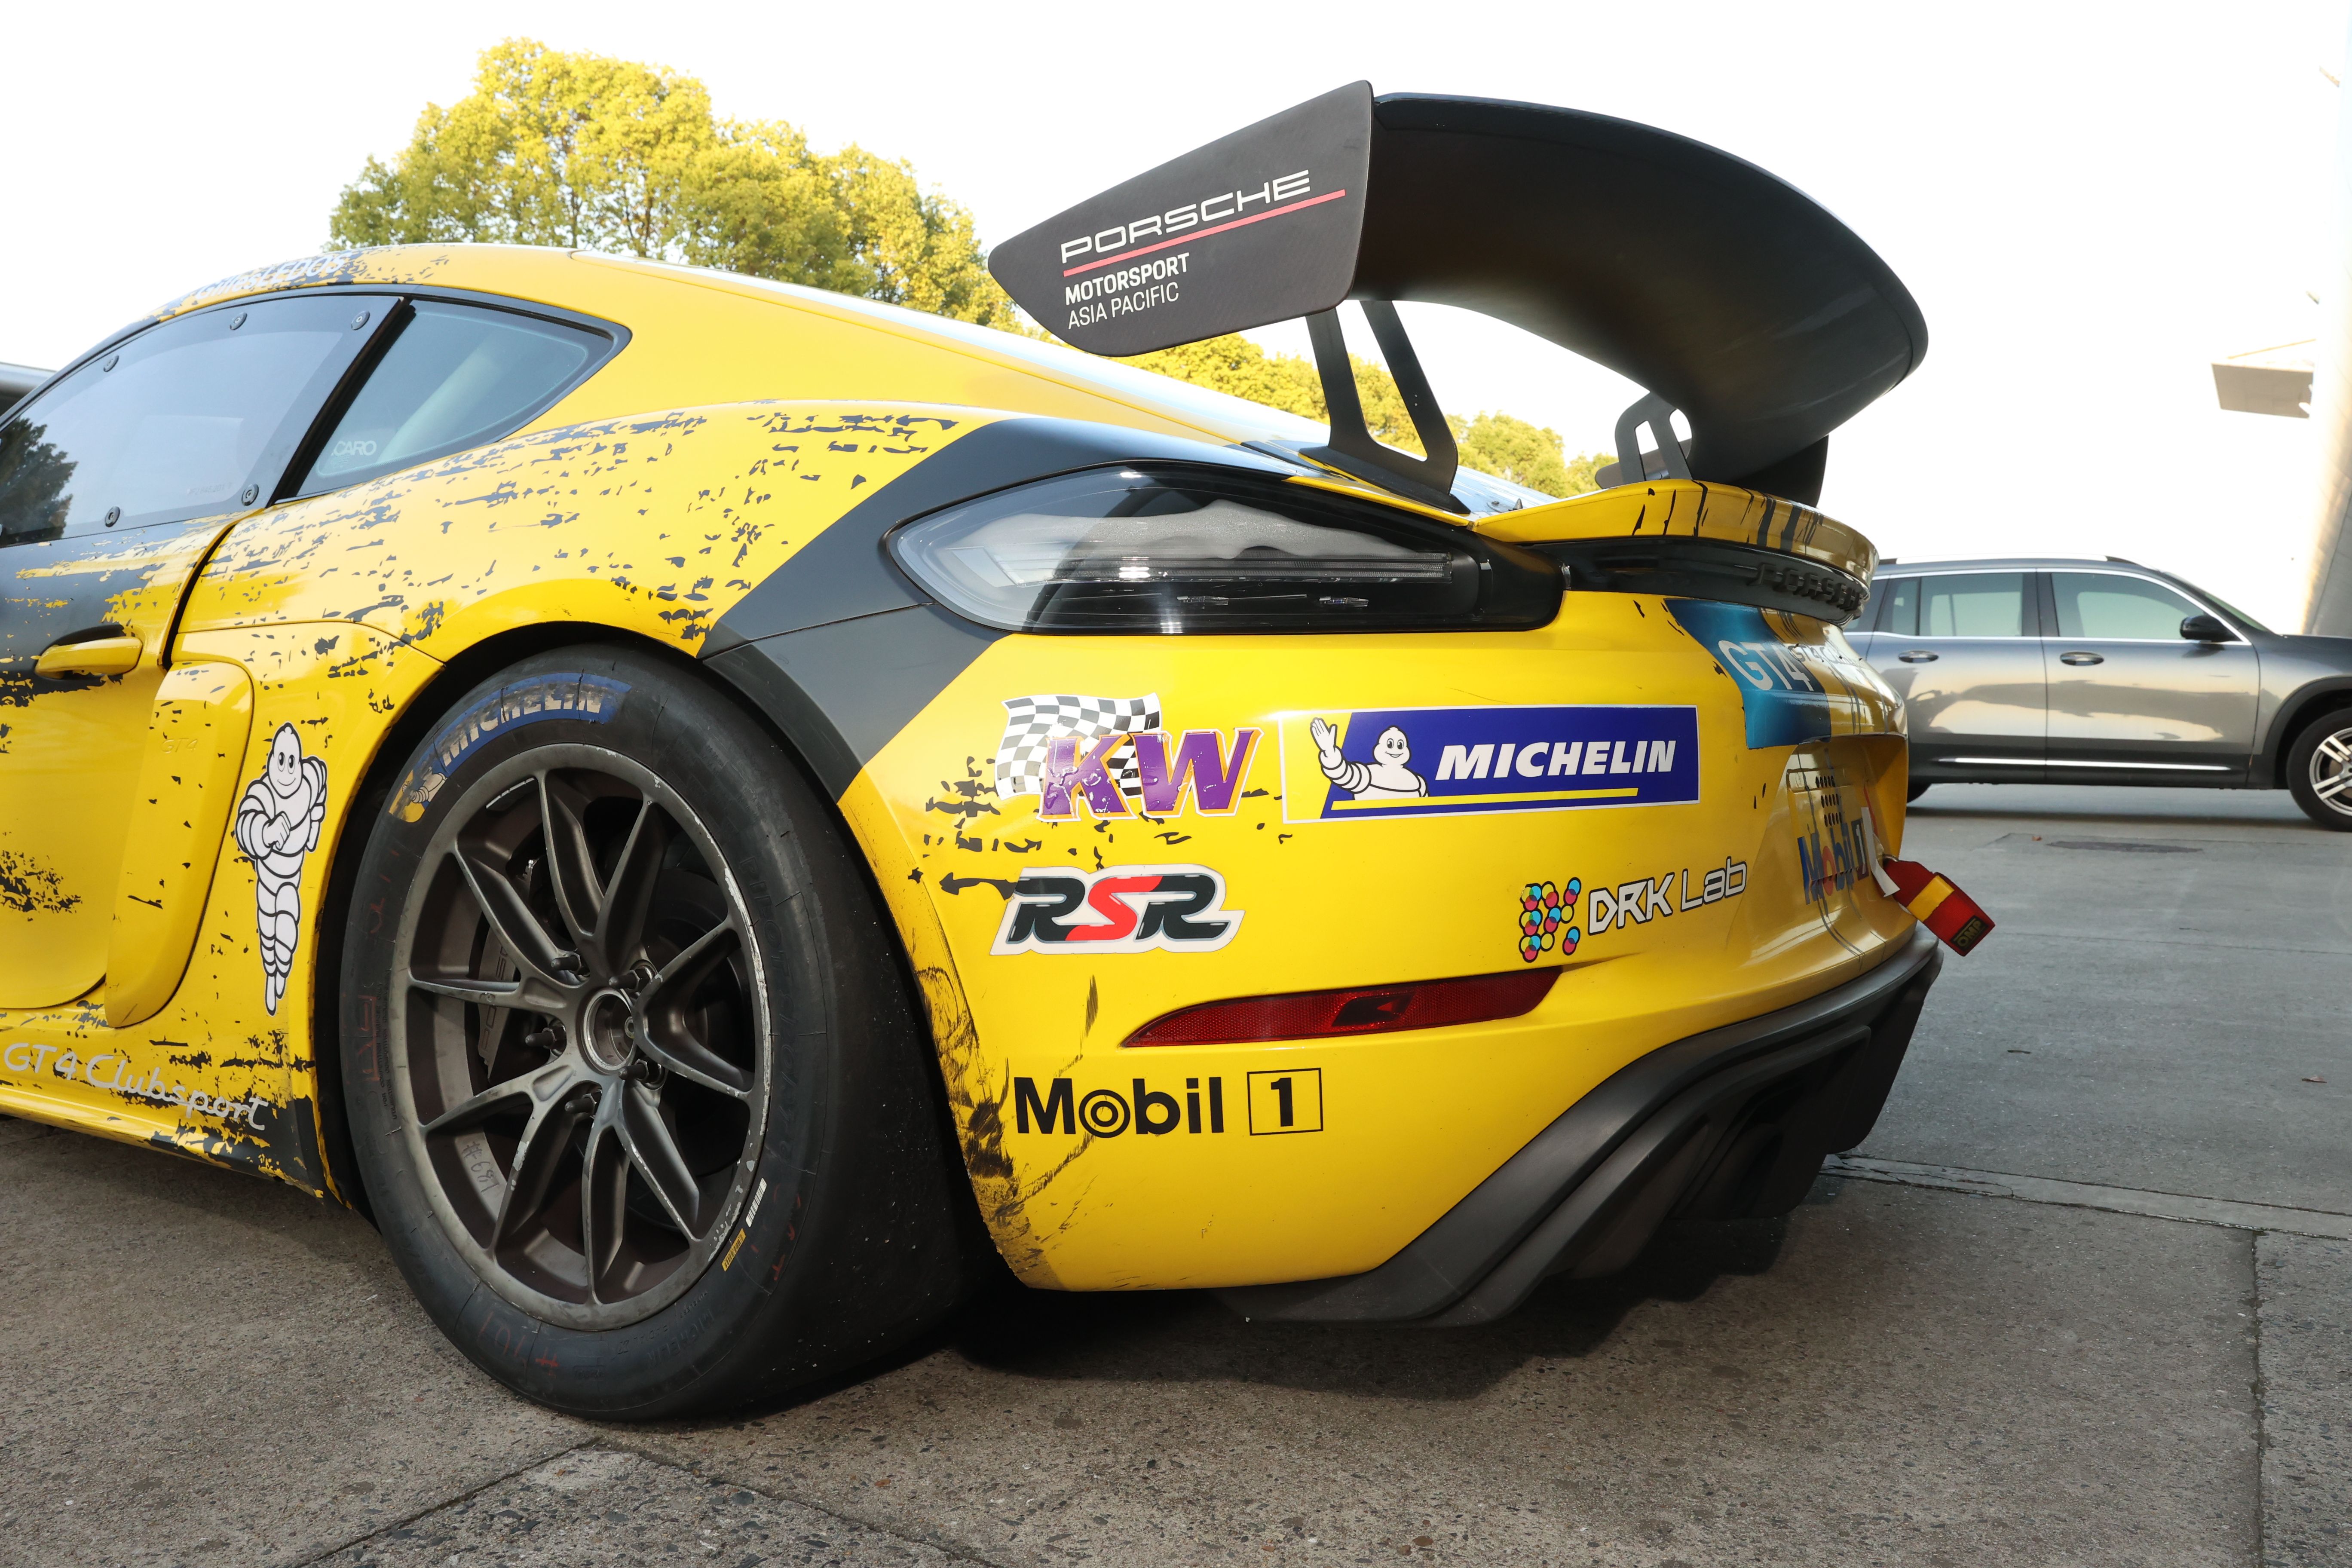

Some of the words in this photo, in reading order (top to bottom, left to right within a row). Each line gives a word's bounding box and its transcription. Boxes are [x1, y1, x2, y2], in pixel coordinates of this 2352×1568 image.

[1061, 169, 1311, 264] PORSCHE
[1065, 252, 1190, 305] MOTORSPORT
[1068, 297, 1107, 329] ASIA
[1112, 282, 1179, 318] PACIFIC
[1749, 562, 1861, 611] PORSCH
[1718, 640, 1814, 692] GT4
[1037, 729, 1263, 821] KW
[1435, 740, 1676, 780] MICHELIN
[1005, 872, 1232, 944] RSR
[1587, 871, 1675, 935] DRK
[1681, 856, 1748, 913] Lab
[1957, 920, 1981, 947] OMP
[86, 1055, 269, 1130] Clubsport
[1013, 1076, 1225, 1139] Mobil
[1270, 1077, 1294, 1127] 1
